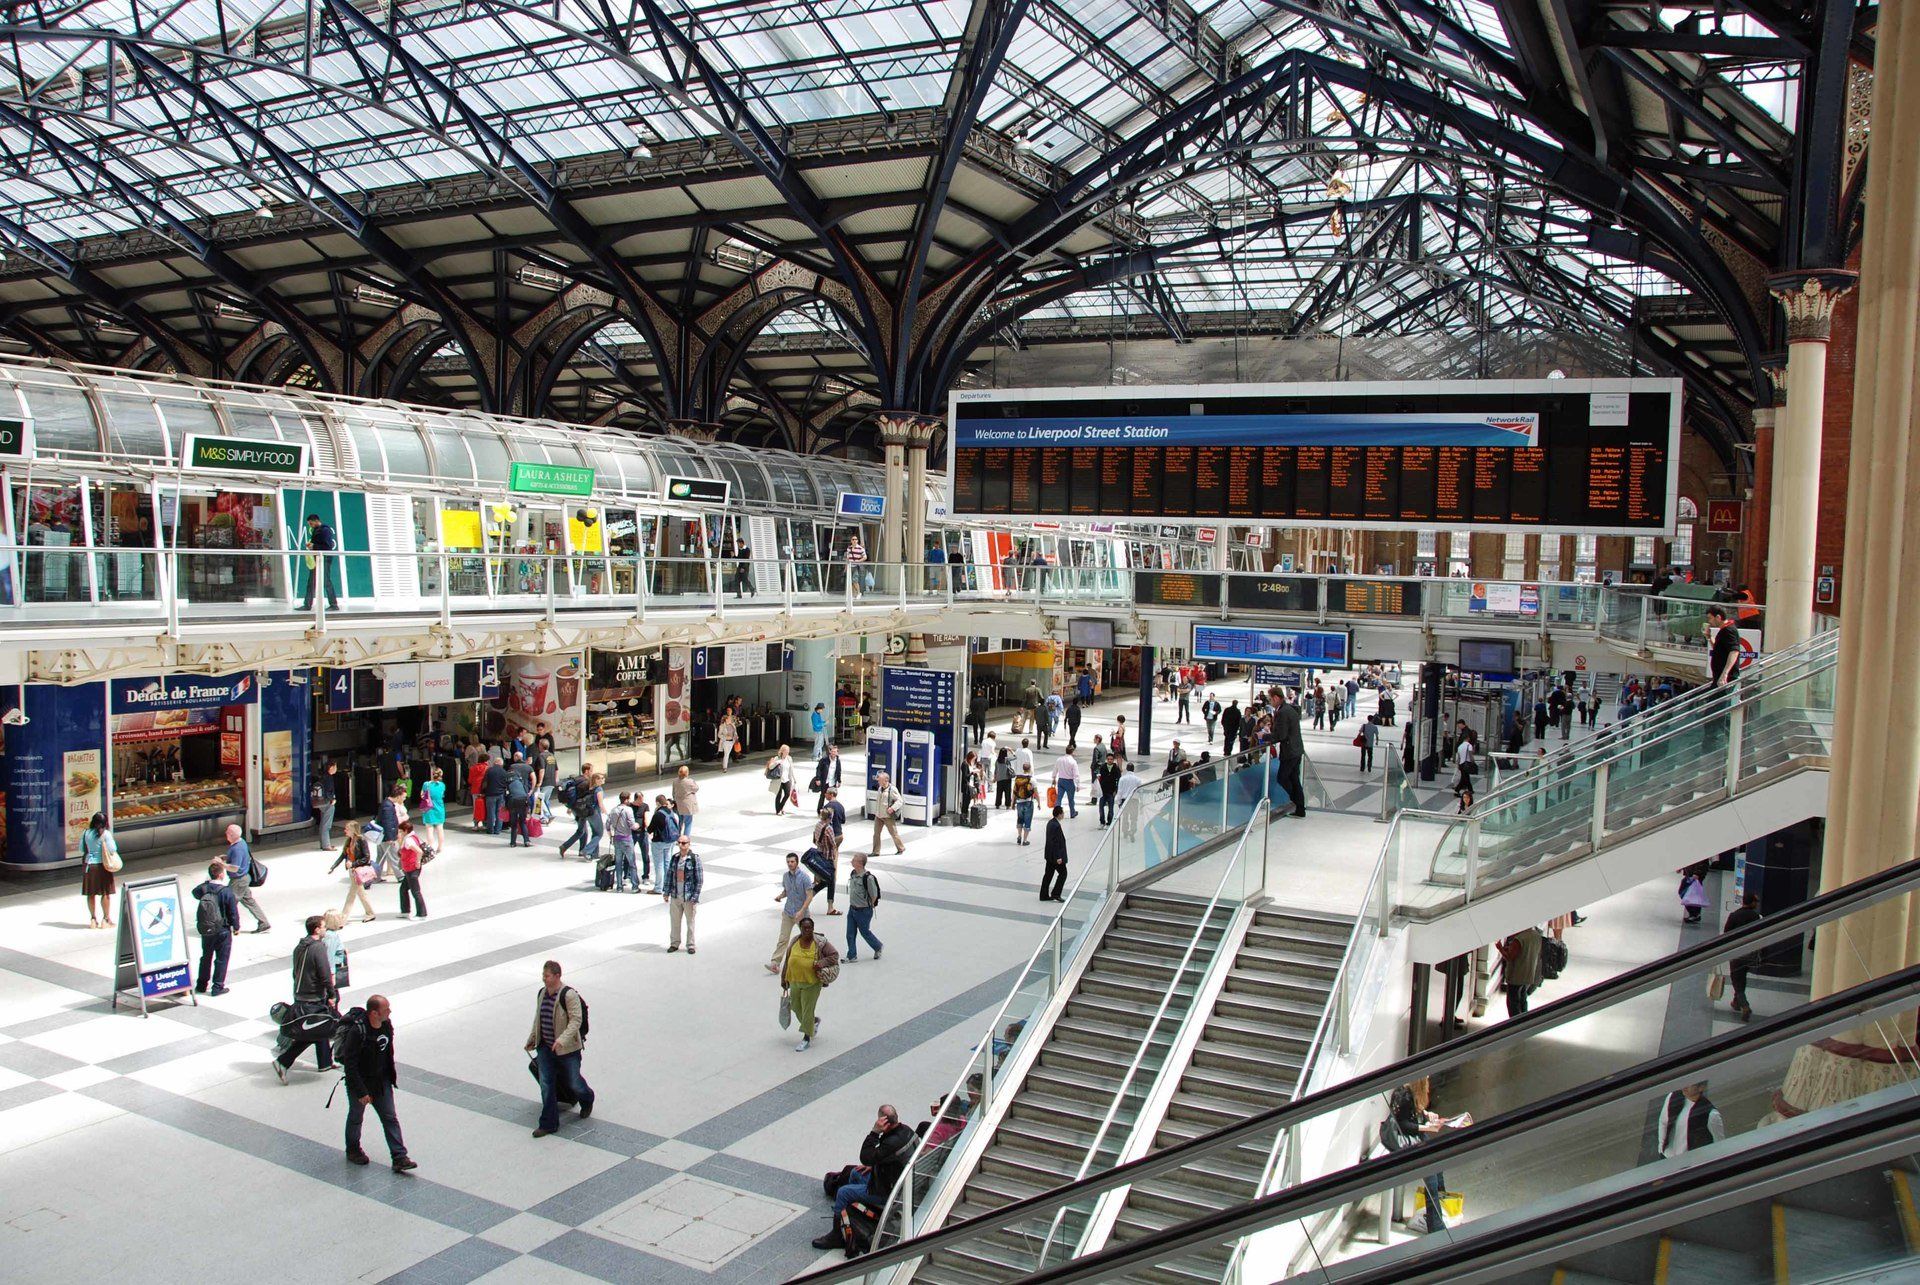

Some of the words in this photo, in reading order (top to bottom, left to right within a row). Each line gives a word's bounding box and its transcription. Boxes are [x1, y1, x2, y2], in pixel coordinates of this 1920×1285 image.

[960, 393, 992, 401] Departures
[975, 429, 1015, 439] Welcome
[1016, 430, 1027, 439] to
[1028, 426, 1081, 442] Liverpool
[1084, 426, 1121, 439] Street
[1123, 425, 1169, 438] Station
[200, 447, 226, 460] M&S
[226, 449, 264, 463] SIMPLY
[264, 451, 295, 465] FOOD
[519, 468, 550, 480] LAURA
[553, 472, 591, 483] ASHLEY
[696, 651, 704, 666] 6
[783, 648, 792, 659] 7
[617, 655, 648, 670] AMT
[486, 665, 496, 680] 5
[616, 670, 647, 681] COFFEE
[335, 674, 348, 694] 4
[388, 680, 416, 690] stansted
[424, 679, 449, 688] express
[171, 686, 187, 700] de
[188, 685, 230, 699] France
[70, 800, 89, 813] PIZZA
[155, 967, 186, 981] Liverpool
[156, 979, 178, 990] Street
